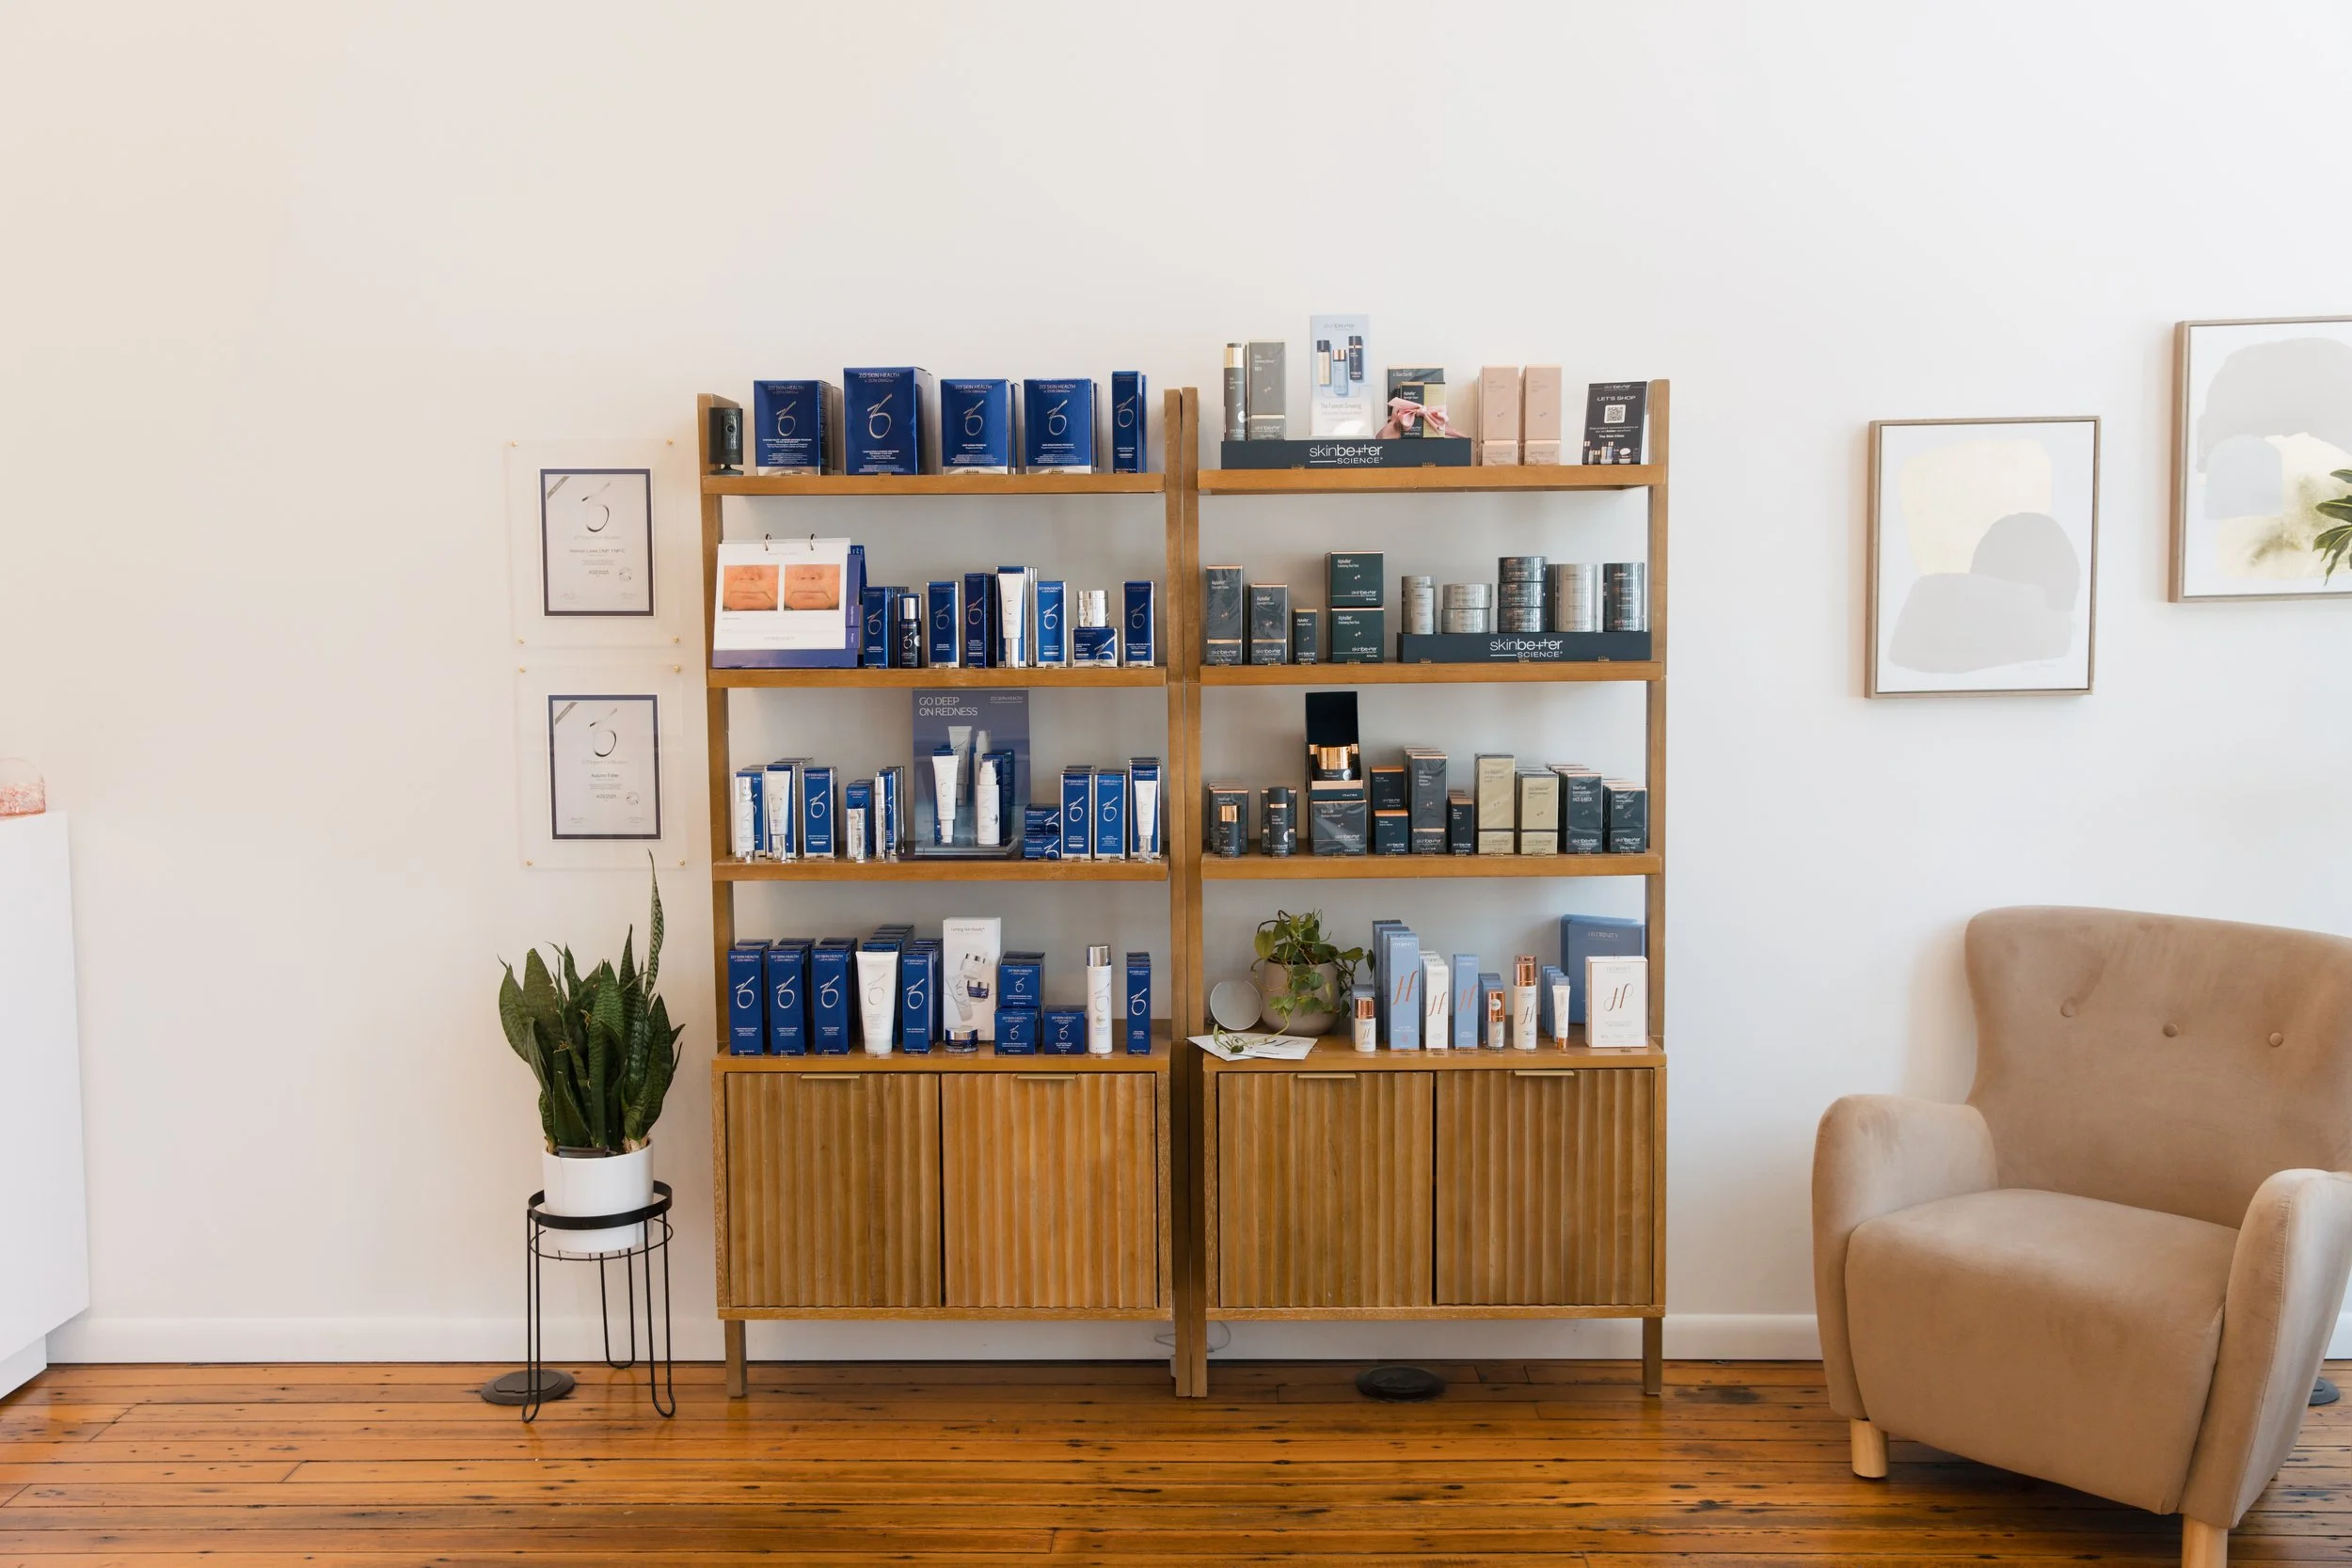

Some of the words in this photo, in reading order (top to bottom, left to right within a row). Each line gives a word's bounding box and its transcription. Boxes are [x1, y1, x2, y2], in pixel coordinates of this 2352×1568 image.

[919, 697, 933, 706] GO
[935, 697, 959, 705] DEEP
[919, 707, 934, 716] ON
[935, 707, 978, 716] REDNESS
